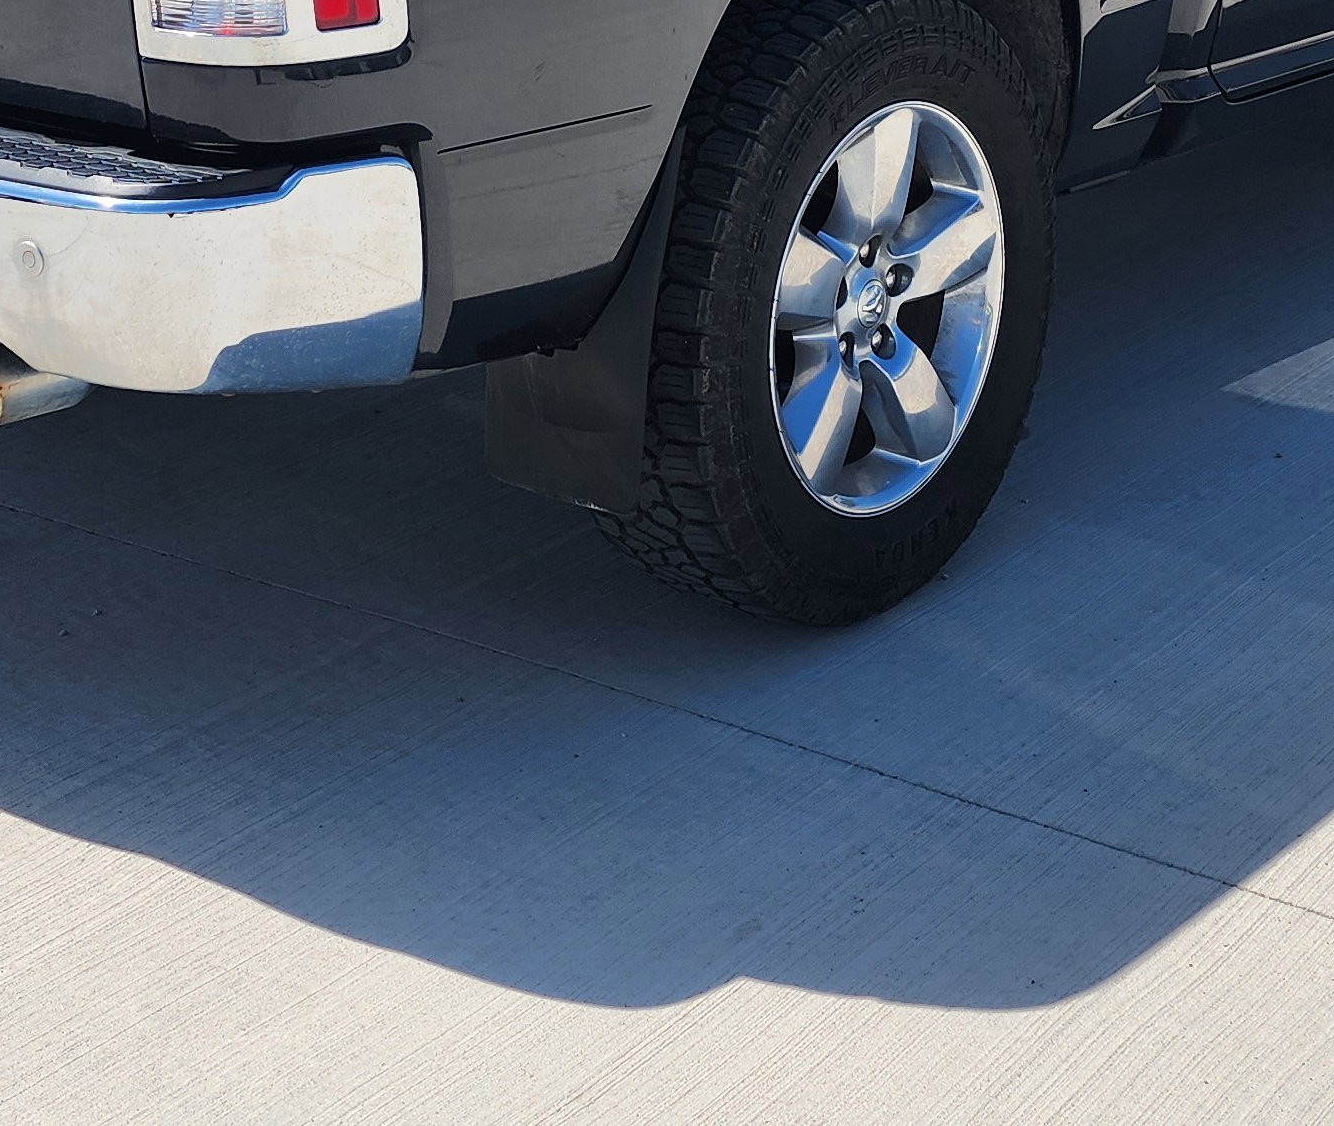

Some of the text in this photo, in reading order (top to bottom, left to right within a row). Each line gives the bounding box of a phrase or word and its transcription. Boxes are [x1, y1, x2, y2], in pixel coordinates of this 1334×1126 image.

[830, 52, 976, 135] KLEVER A/T
[870, 496, 958, 569] KENDA
